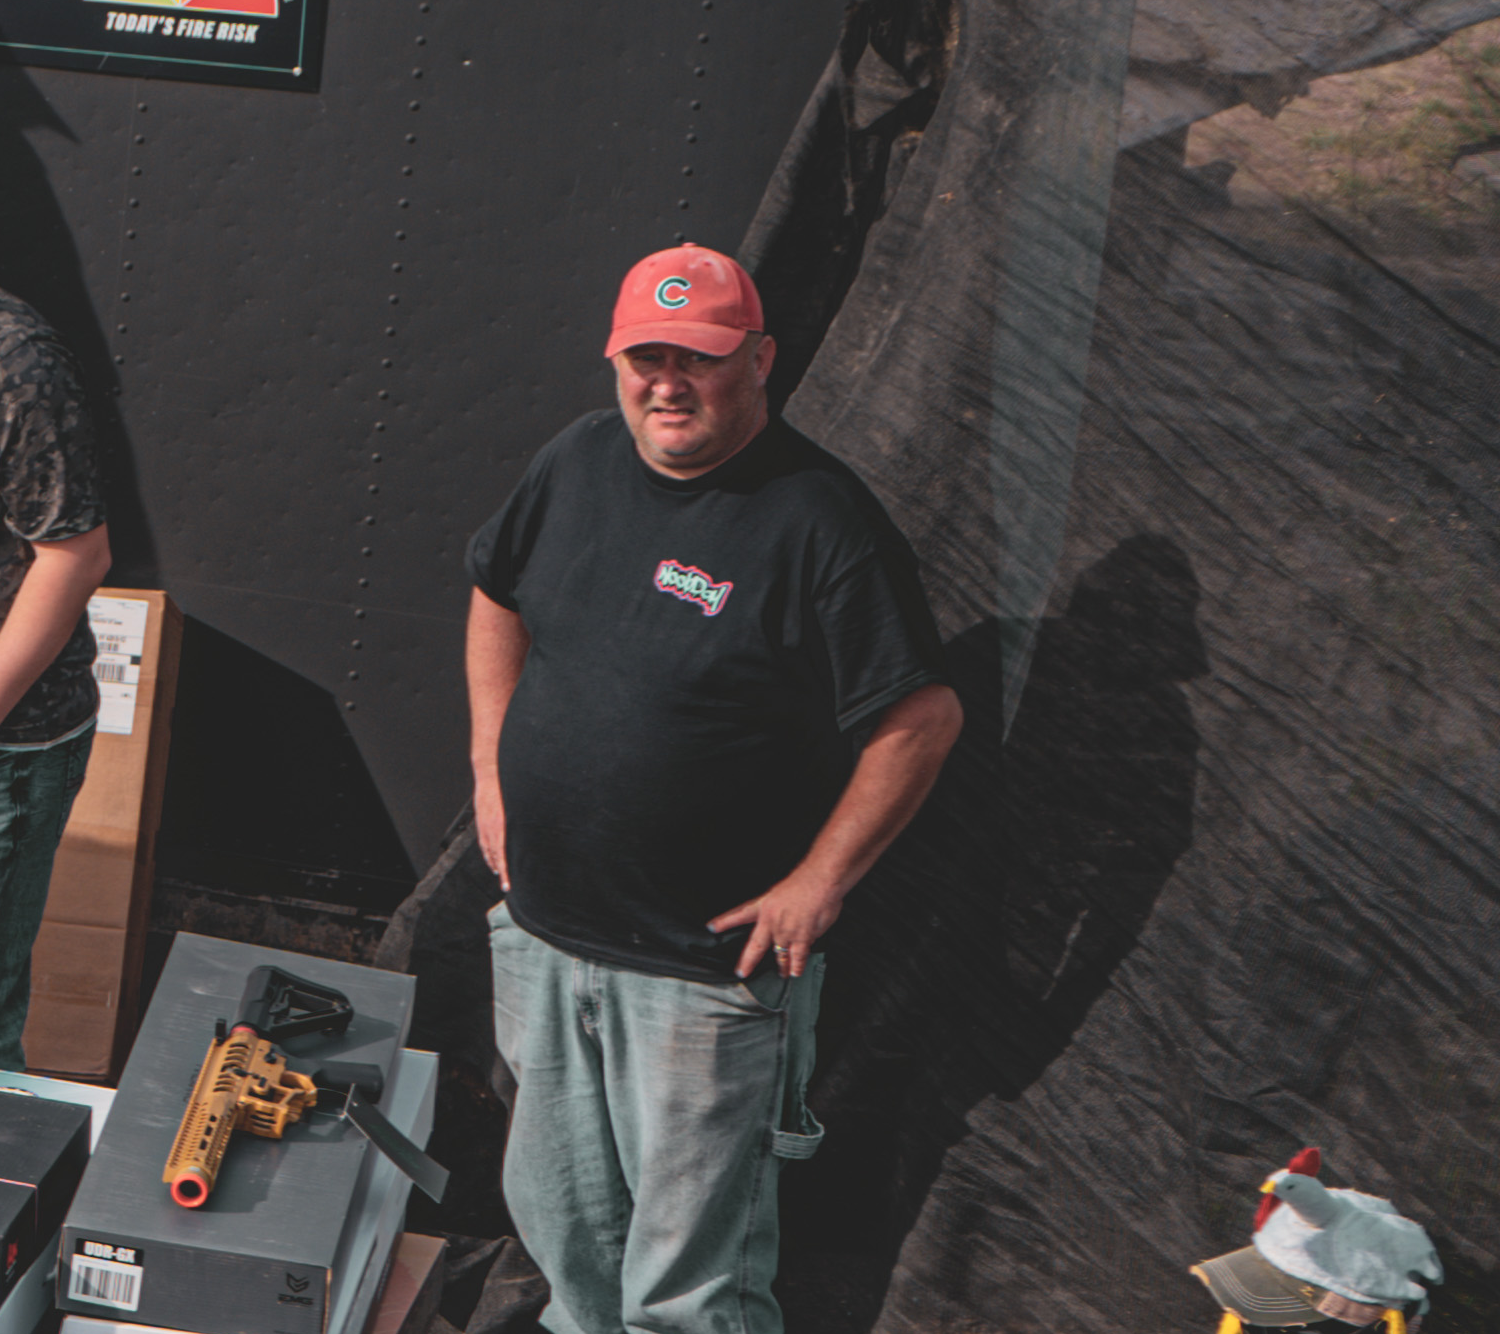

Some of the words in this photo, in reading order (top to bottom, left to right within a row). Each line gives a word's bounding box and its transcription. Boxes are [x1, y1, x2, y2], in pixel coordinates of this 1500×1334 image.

[105, 12, 174, 35] TODAY'S
[175, 19, 214, 39] FIRE
[215, 21, 259, 43] RISK
[655, 276, 691, 309] C
[84, 1240, 136, 1263] UDR-GX
